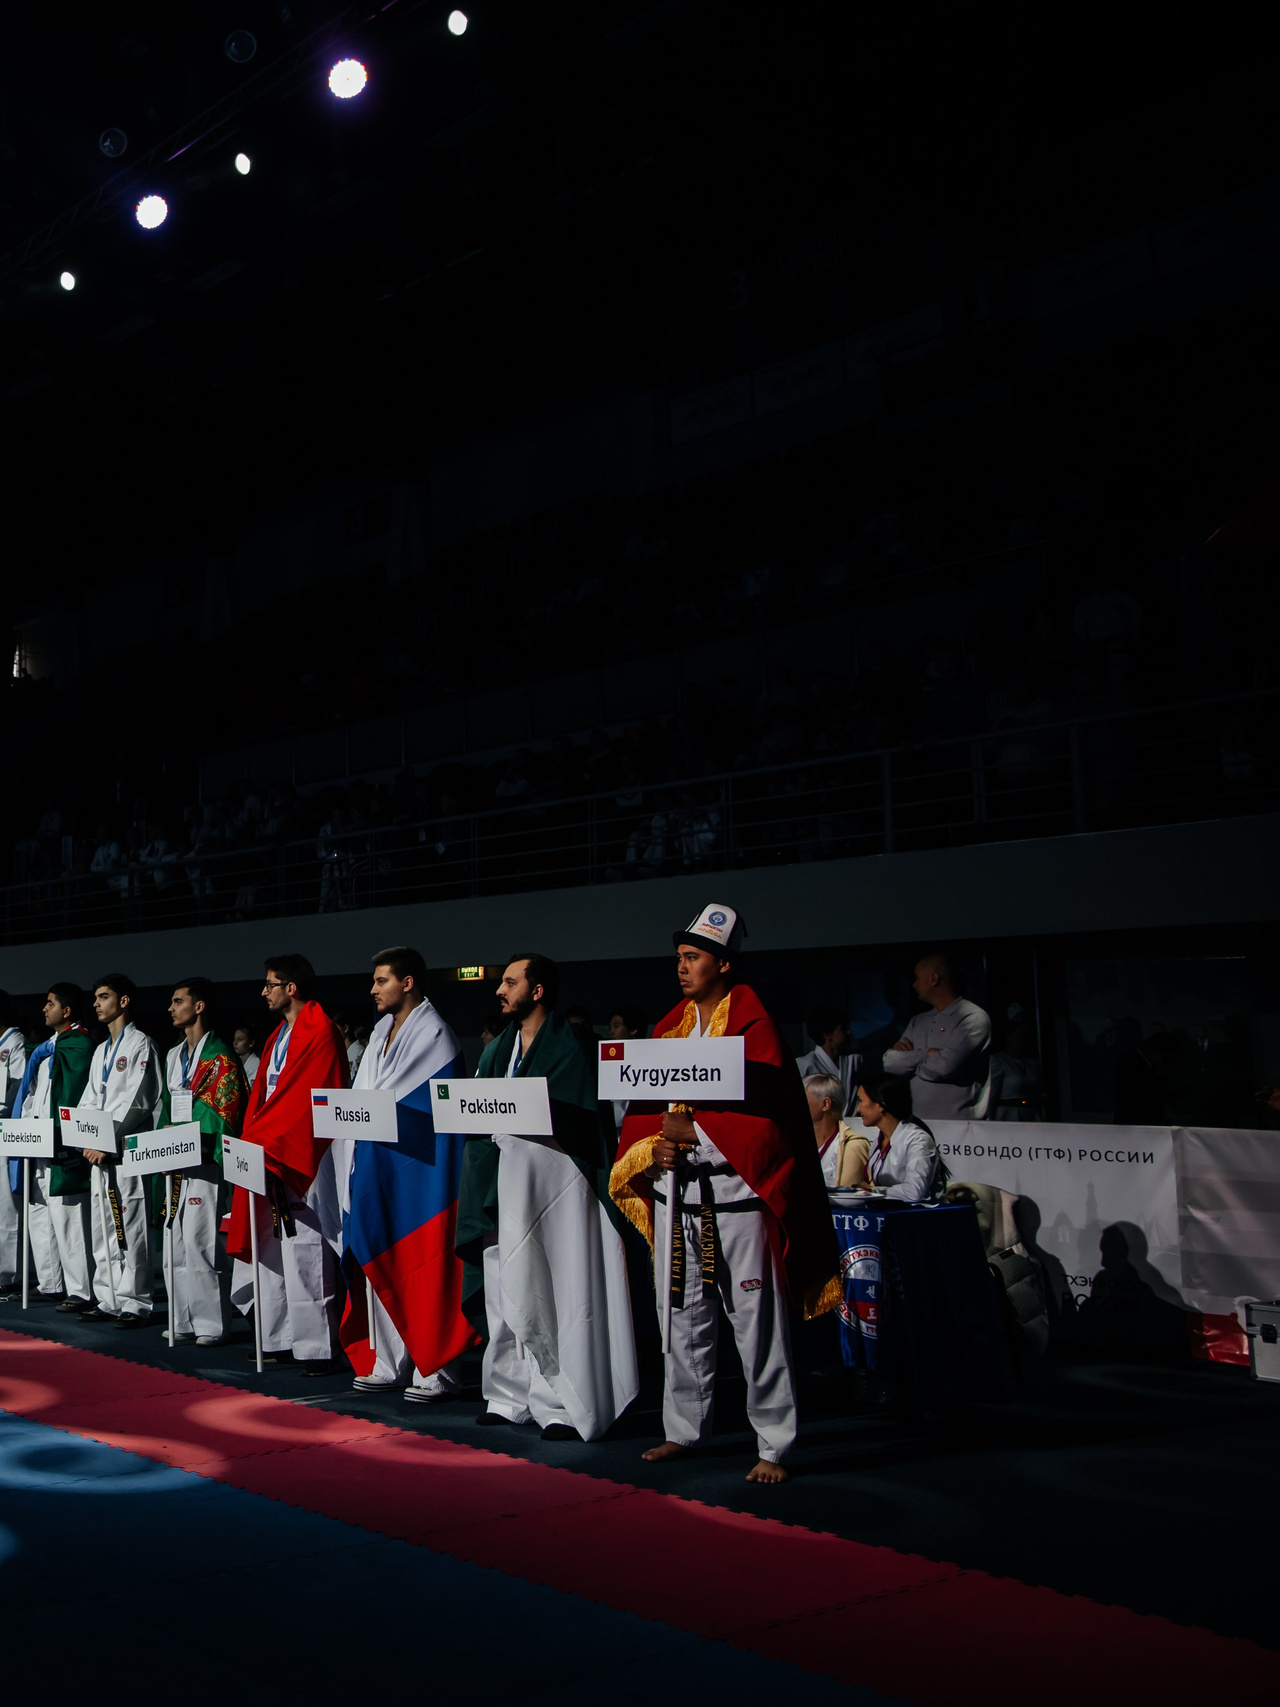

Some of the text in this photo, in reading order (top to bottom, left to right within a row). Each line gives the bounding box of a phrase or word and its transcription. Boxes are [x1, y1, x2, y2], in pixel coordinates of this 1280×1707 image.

[619, 1064, 722, 1087] Kyrgyzstan
[334, 1106, 371, 1123] Russia
[459, 1098, 517, 1115] Pakistan
[2, 1131, 42, 1144] Uzbekistan
[75, 1120, 99, 1138] Turkey
[129, 1141, 196, 1163] Turkmenistan
[1027, 1146, 1072, 1163] (ГТФ)
[1078, 1148, 1155, 1165] РОССИИ
[235, 1155, 249, 1173] Syria
